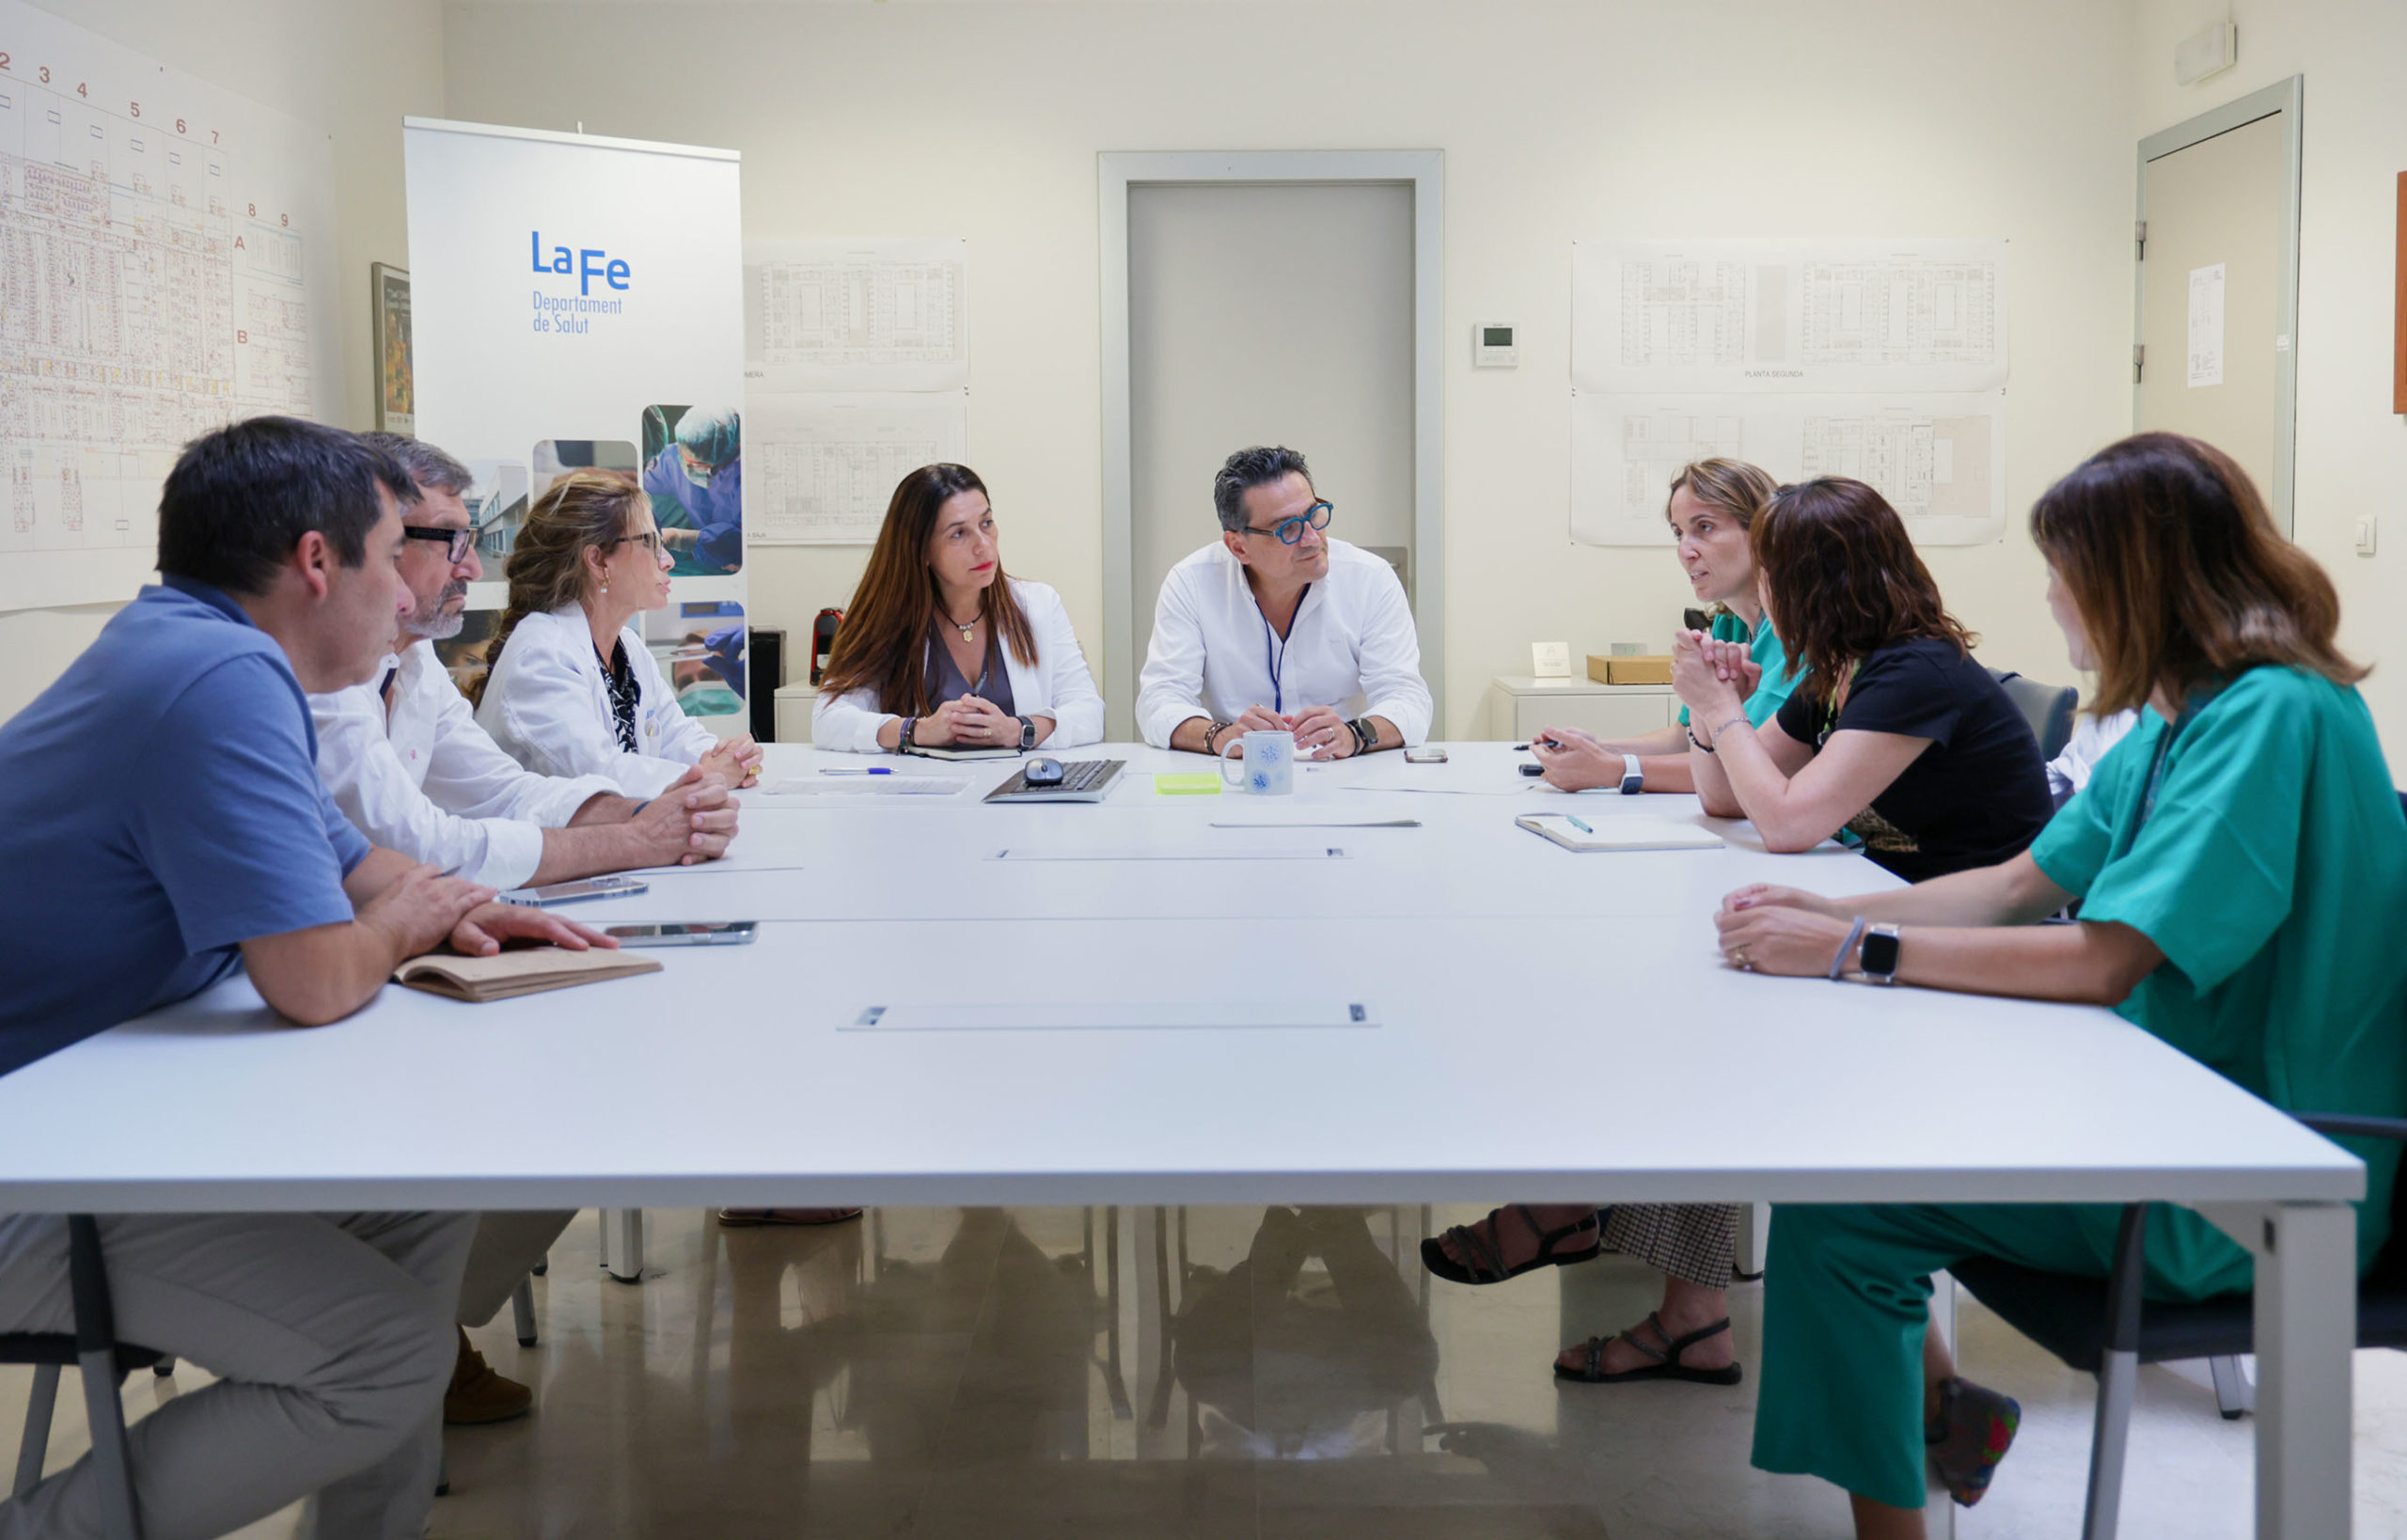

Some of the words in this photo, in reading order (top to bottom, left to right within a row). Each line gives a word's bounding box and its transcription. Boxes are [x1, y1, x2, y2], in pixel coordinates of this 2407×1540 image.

[0, 52, 11, 71] 2
[39, 66, 51, 85] 3
[76, 82, 88, 99] 4
[130, 101, 141, 118] 5
[176, 118, 187, 134] 6
[211, 130, 220, 145] 7
[248, 202, 257, 218] 8
[280, 212, 290, 228] 9
[234, 235, 246, 251] A
[532, 230, 573, 275] La
[580, 249, 631, 296] Fe
[533, 291, 622, 316] Departament
[533, 312, 550, 333] de
[555, 313, 589, 334] Salut
[237, 329, 248, 344] B
[744, 370, 764, 379] MERA
